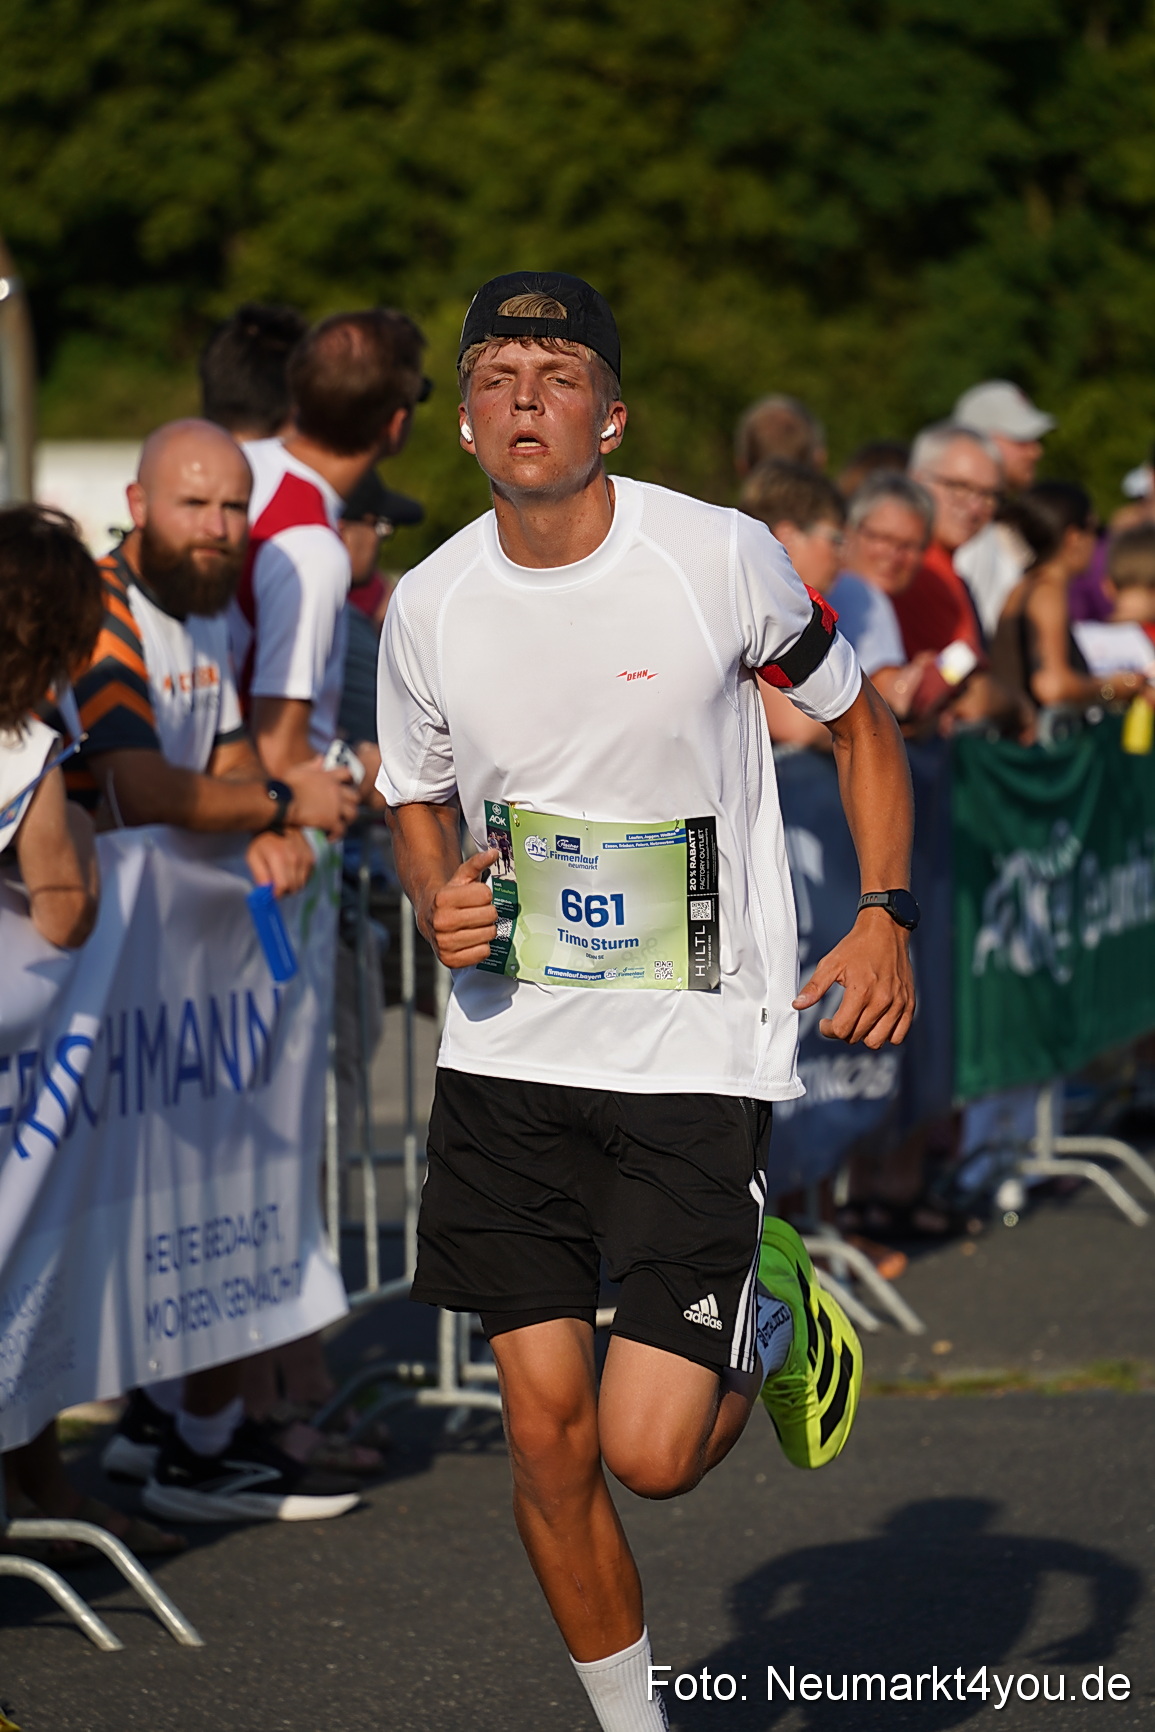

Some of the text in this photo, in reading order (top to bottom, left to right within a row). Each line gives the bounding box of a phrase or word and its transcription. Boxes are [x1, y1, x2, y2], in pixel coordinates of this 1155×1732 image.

[627, 669, 648, 681] DEHN
[489, 815, 507, 826] AOK
[697, 828, 706, 859] OUTLET
[550, 850, 599, 864] Firmenlauf
[568, 863, 598, 871] neumarkt
[688, 829, 697, 890] 20 % RABATT
[562, 888, 625, 928] 661
[557, 928, 639, 951] Timo Sturm
[695, 925, 706, 977] HILTL
[547, 968, 602, 981] firmenlauf.bayern
[683, 1310, 723, 1331] adidas
